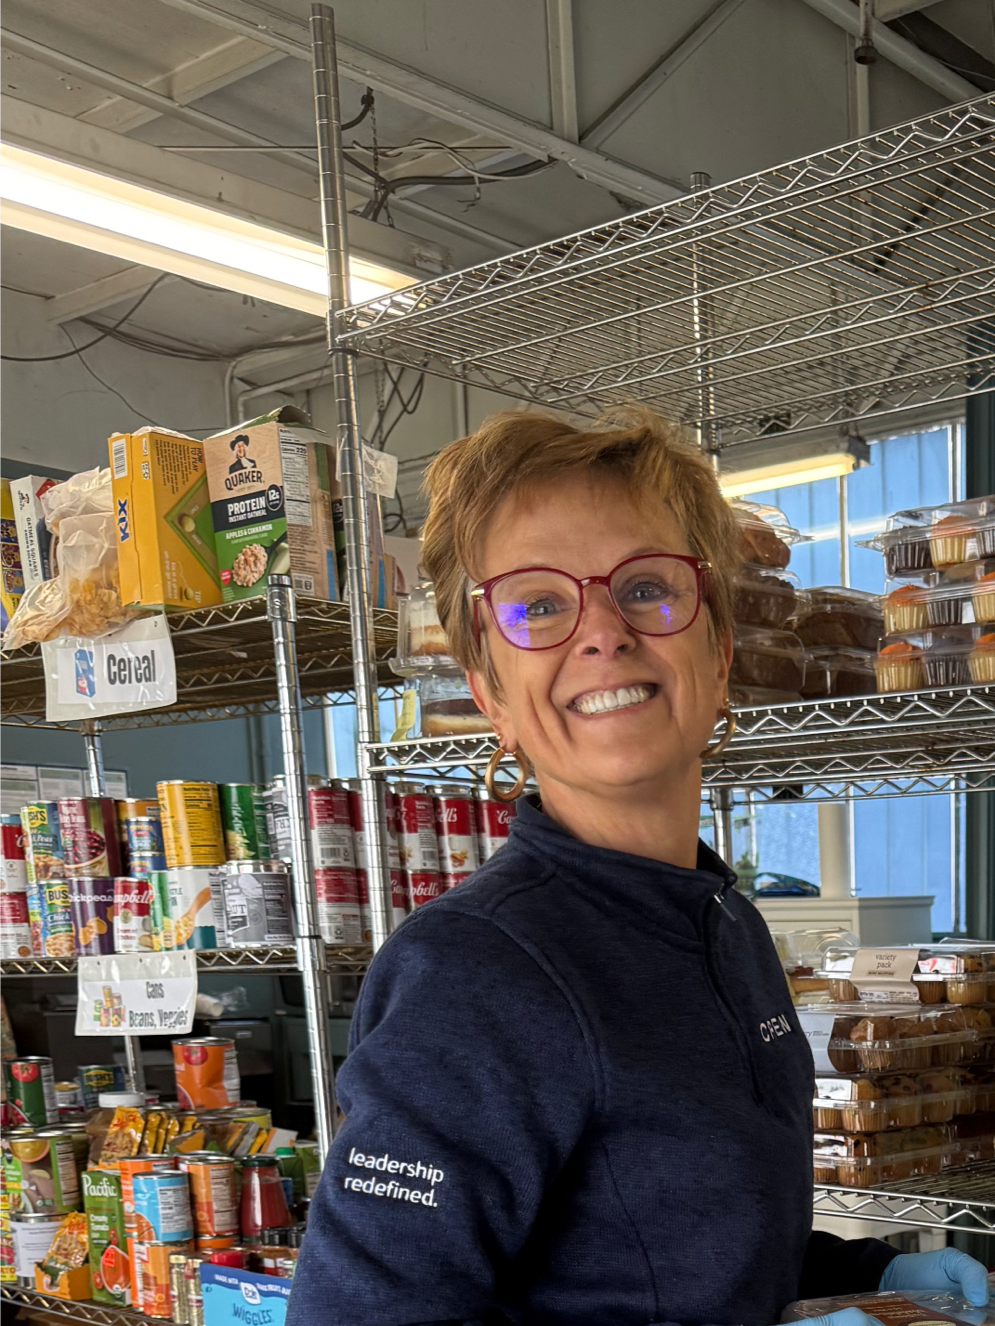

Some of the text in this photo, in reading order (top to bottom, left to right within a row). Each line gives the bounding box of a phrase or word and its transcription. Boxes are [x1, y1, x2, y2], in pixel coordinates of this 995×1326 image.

[224, 470, 264, 491] QUAKER
[227, 496, 266, 517] PROTEIN
[106, 649, 156, 686] Cereal
[47, 889, 69, 902] BUS
[875, 953, 897, 962] variety
[876, 961, 892, 969] pack
[146, 981, 164, 999] Cans
[129, 1007, 189, 1029] Beans, Veggies
[348, 1147, 444, 1187] leadership
[82, 1174, 118, 1198] Pacific
[344, 1176, 438, 1208] redefined.
[232, 1303, 274, 1326] WIGGLES
